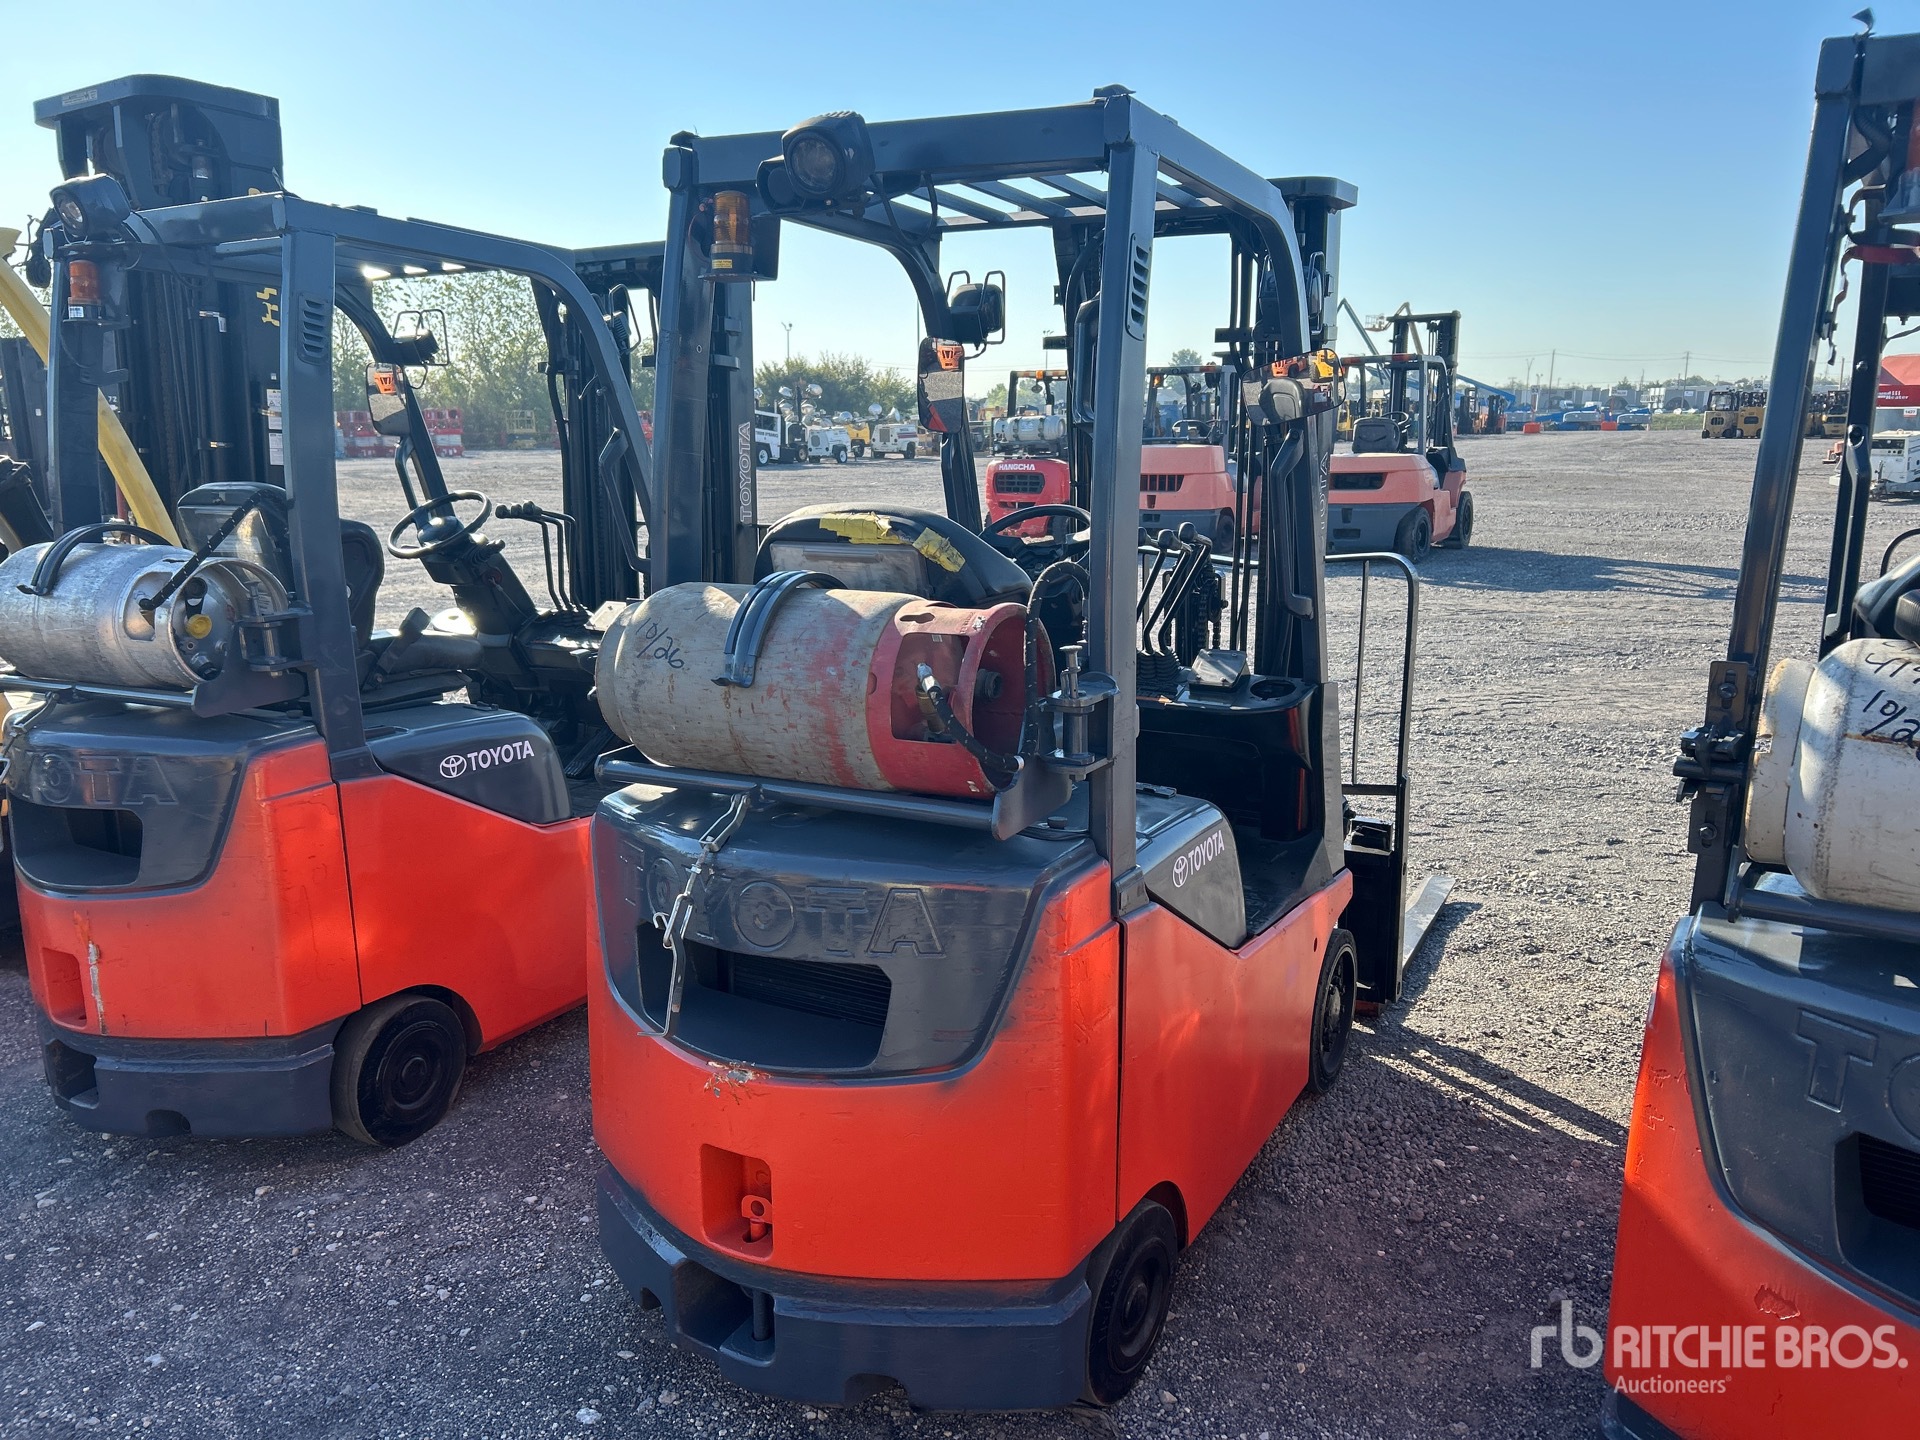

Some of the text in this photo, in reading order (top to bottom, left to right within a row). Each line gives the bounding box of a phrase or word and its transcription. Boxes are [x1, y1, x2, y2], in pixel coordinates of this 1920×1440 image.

[738, 421, 752, 523] TOYOTA
[999, 463, 1036, 471] HANGCHA
[635, 616, 686, 670] 10/26
[1861, 689, 1920, 761] 10/2
[467, 740, 535, 771] TOYOTA
[1188, 829, 1225, 876] TOYOTA
